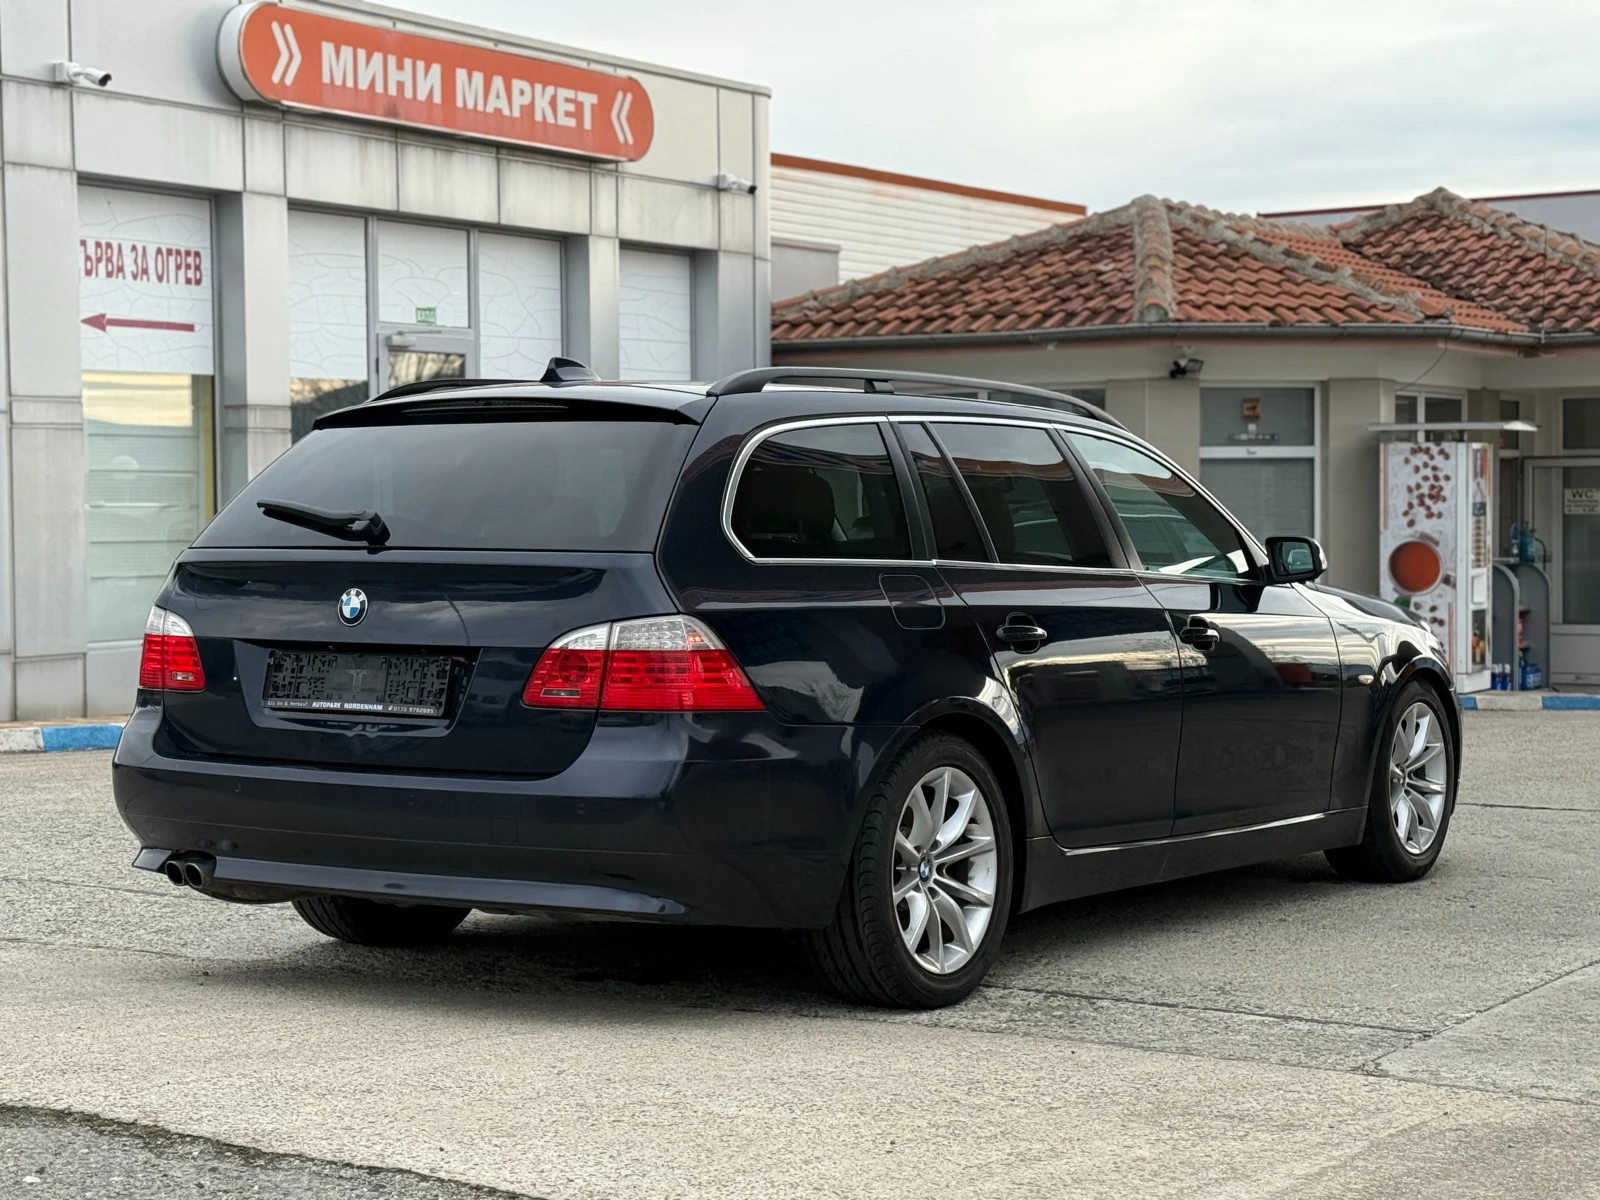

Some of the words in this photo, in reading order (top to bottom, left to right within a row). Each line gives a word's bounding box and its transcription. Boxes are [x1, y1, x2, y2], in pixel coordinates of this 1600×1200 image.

[321, 41, 442, 104] МИНИ
[455, 67, 599, 130] МАРКЕТ
[79, 239, 126, 281] ЪРВА
[130, 243, 150, 282] ЗА
[154, 246, 203, 286] ОГРЕВ
[1571, 489, 1594, 499] WC
[312, 701, 341, 709] AUTOPARK
[343, 702, 383, 711] NORDENHAM
